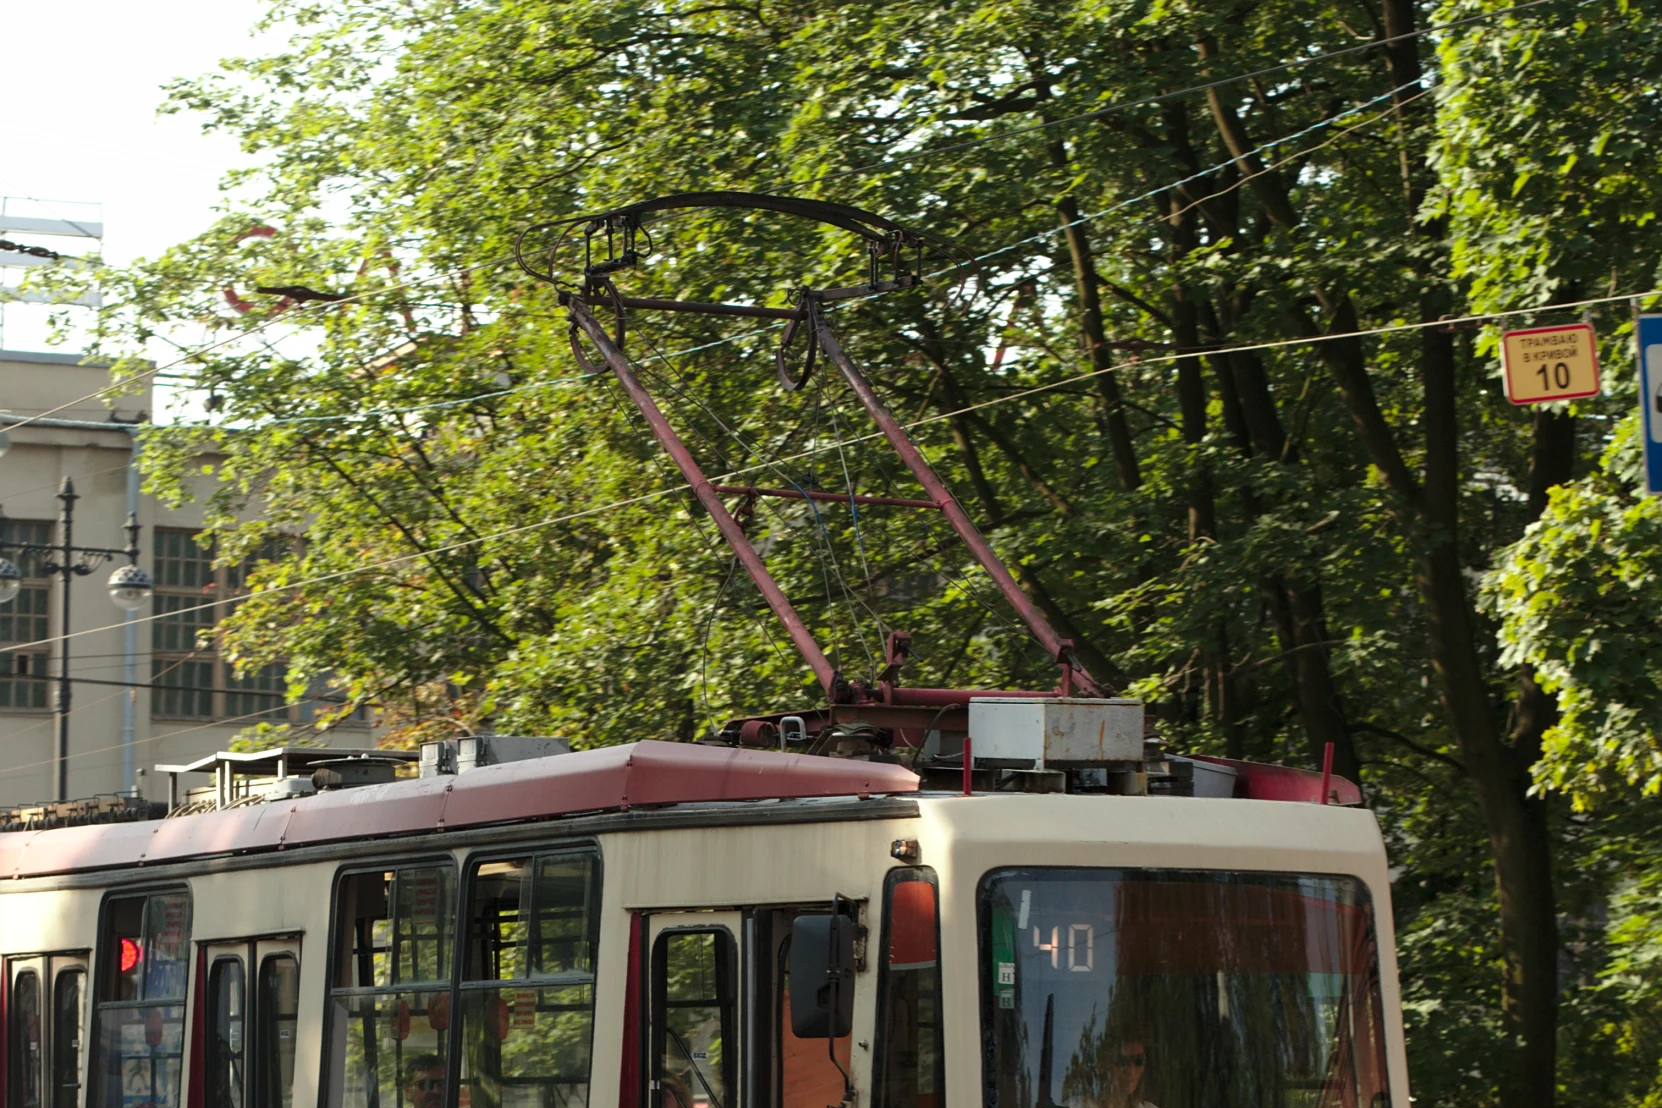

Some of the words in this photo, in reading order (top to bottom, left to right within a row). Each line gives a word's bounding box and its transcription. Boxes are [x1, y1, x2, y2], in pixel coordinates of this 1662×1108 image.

[1520, 334, 1578, 349] ТРАМВАЮ
[1523, 352, 1531, 363] В
[1533, 345, 1578, 362] КРИВОЙ
[1536, 362, 1570, 391] 10
[1033, 923, 1094, 972] 40
